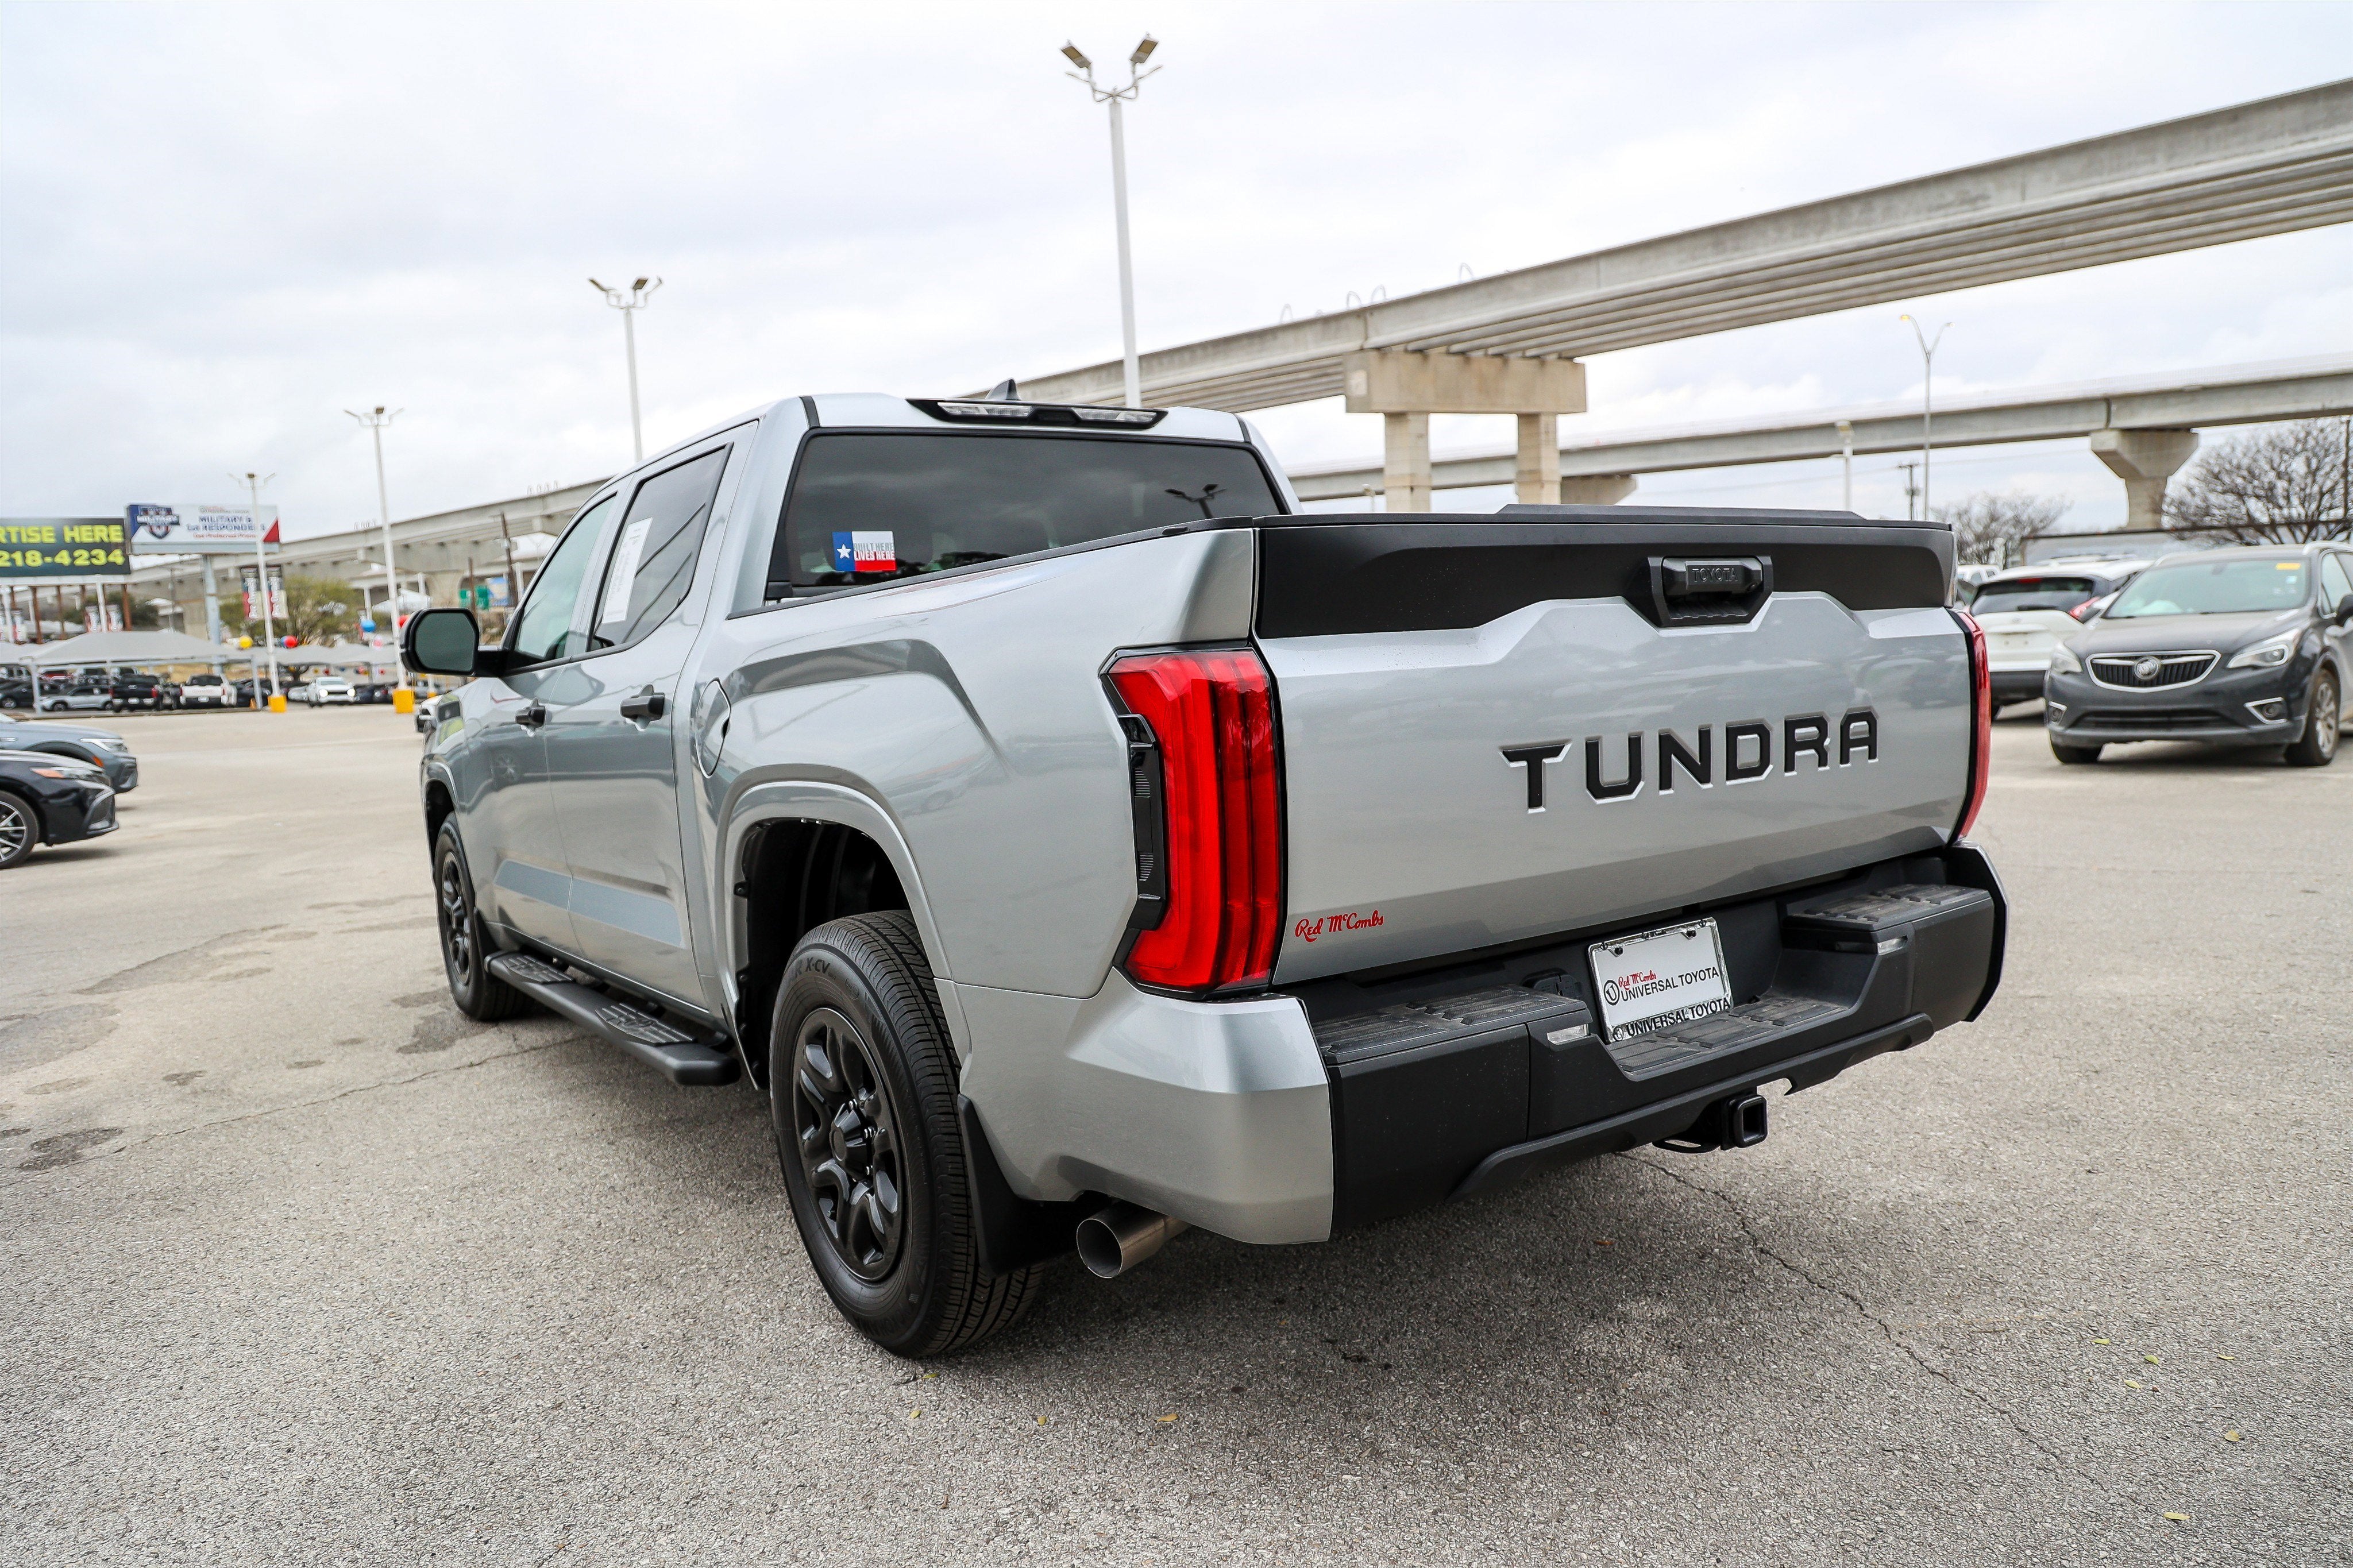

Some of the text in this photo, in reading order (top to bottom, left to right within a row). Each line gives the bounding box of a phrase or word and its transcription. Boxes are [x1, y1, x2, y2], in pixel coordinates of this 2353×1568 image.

[63, 524, 124, 543] HERE
[854, 551, 895, 561] LIVES HERE
[875, 542, 894, 551] HERE
[1692, 567, 1738, 582] TOYOTA
[1499, 706, 1878, 813] TUNDRA
[1295, 909, 1384, 943] Red McCombs
[1618, 970, 1657, 991] Red McCombs
[1620, 966, 1720, 1002] UNIVERSAL TOYOTA
[1626, 997, 1731, 1037] UNIVERSAL TOYOTA
